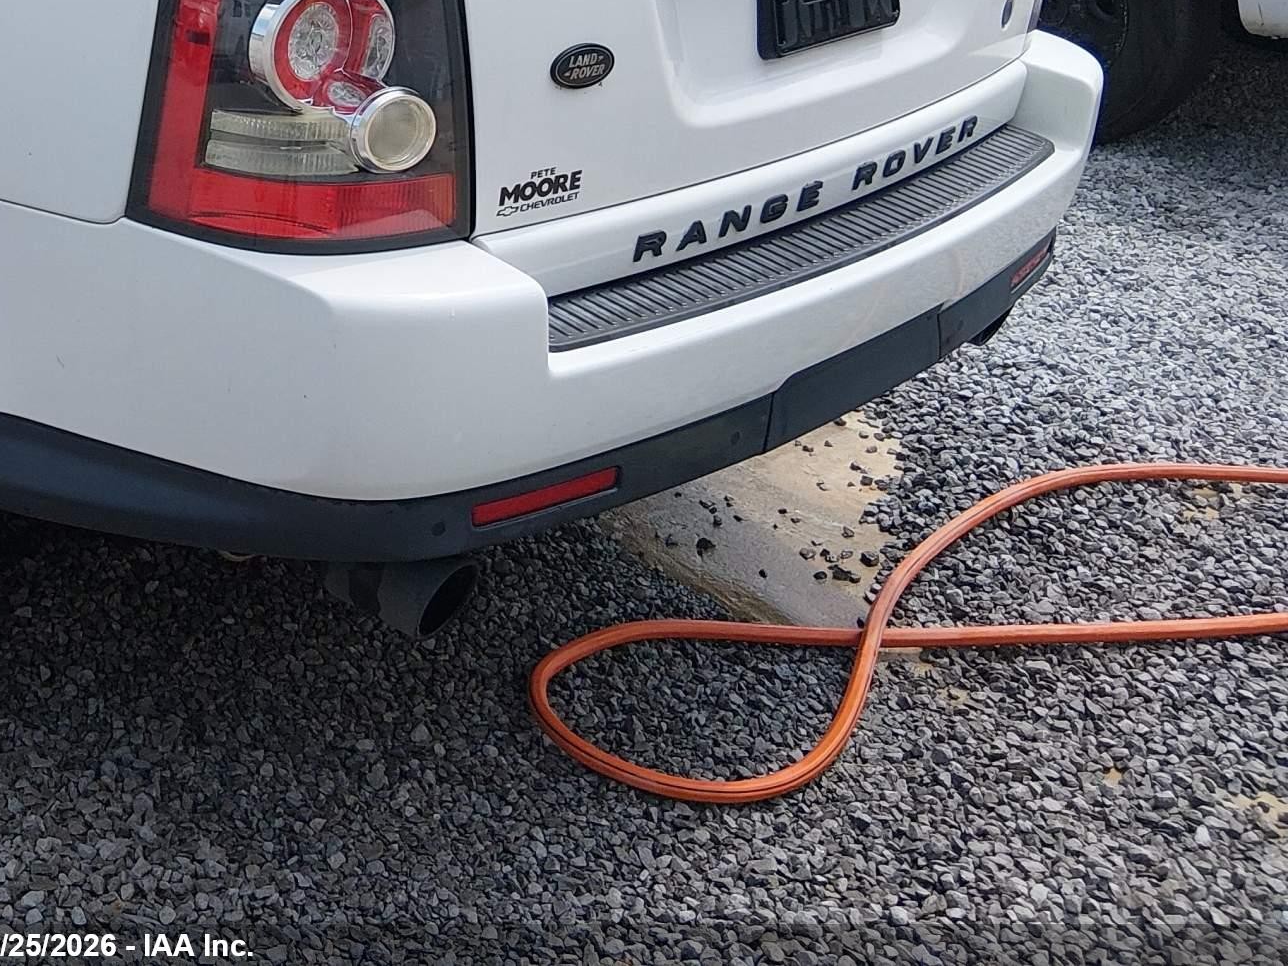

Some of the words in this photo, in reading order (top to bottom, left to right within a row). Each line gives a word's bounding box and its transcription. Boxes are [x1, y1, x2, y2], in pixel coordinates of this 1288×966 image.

[568, 53, 599, 68] LAND
[569, 64, 605, 80] ROVER
[530, 166, 557, 180] PETE
[498, 169, 583, 207] MOORE
[632, 180, 824, 262] RANGE
[852, 115, 978, 191] ROVER
[519, 191, 580, 213] CHEVROLET
